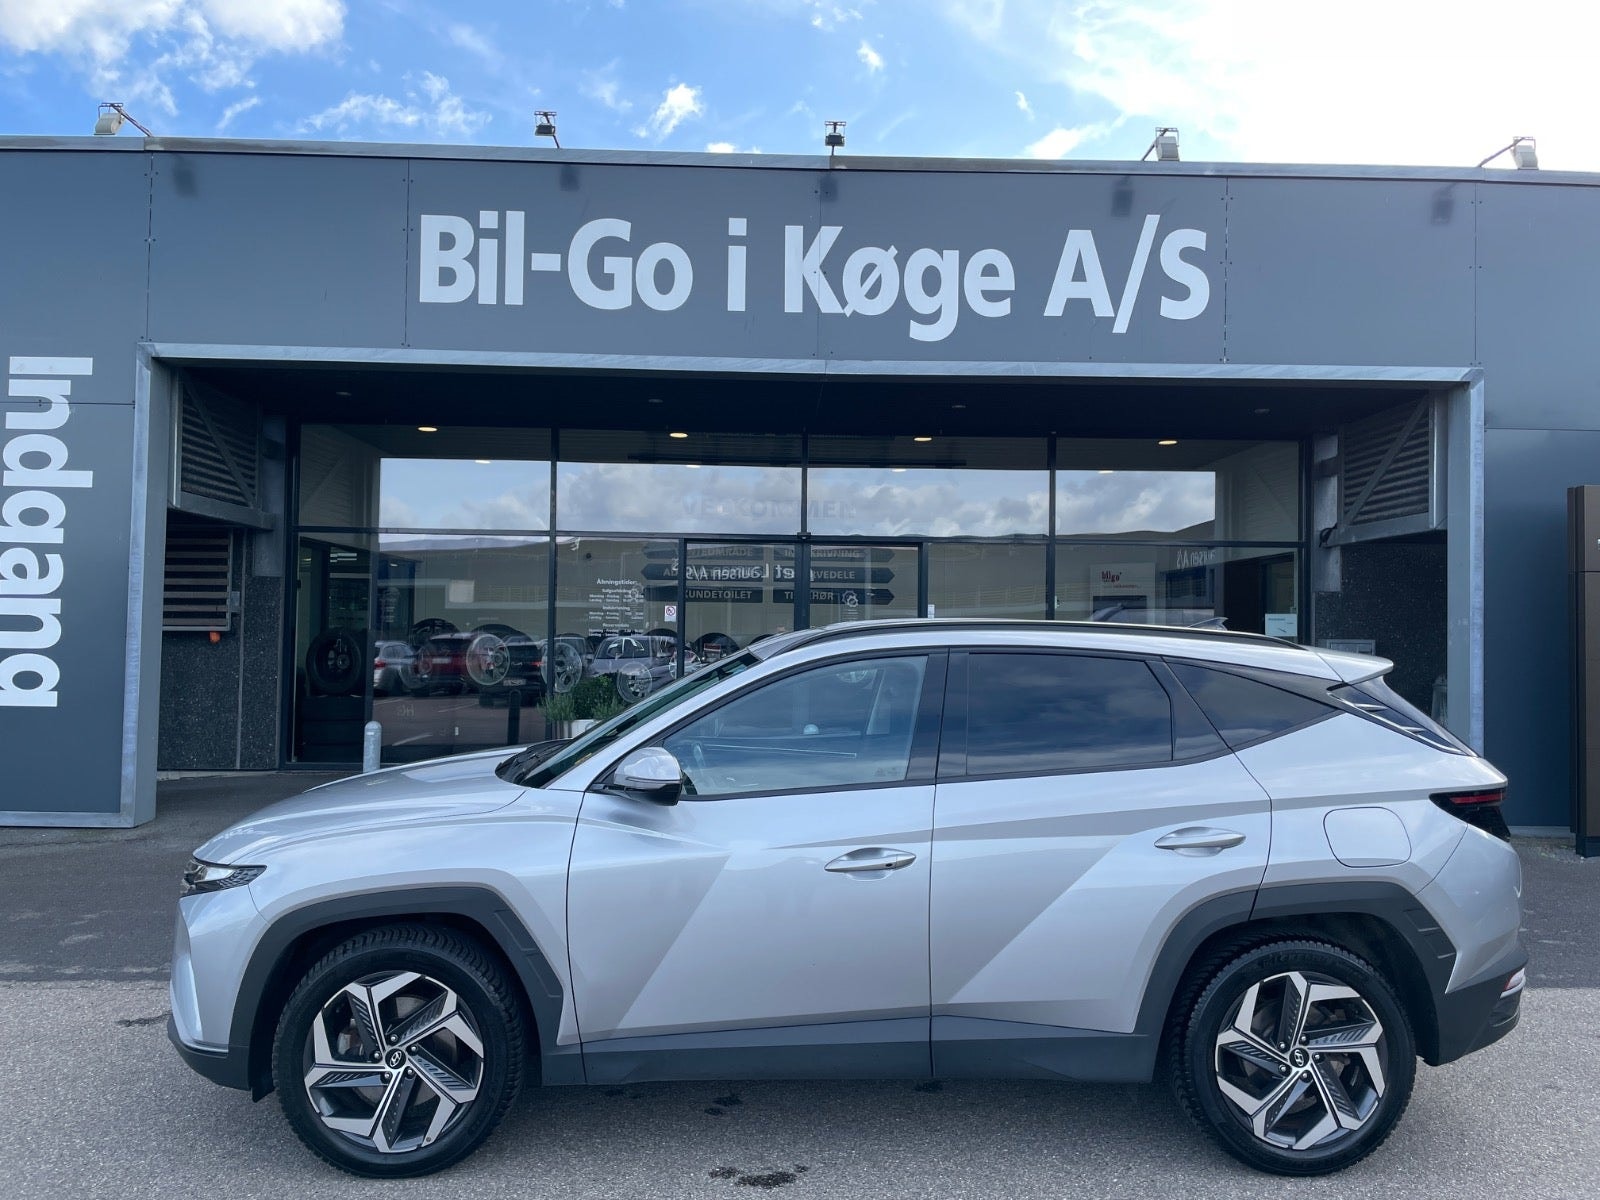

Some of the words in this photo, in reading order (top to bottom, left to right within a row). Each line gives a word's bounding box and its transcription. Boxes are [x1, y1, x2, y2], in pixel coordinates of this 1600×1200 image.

[420, 211, 693, 311] Bil-Go
[727, 217, 747, 312] i
[784, 225, 1015, 342] Køge
[1043, 214, 1210, 333] A/S
[0, 356, 93, 707] Indgang
